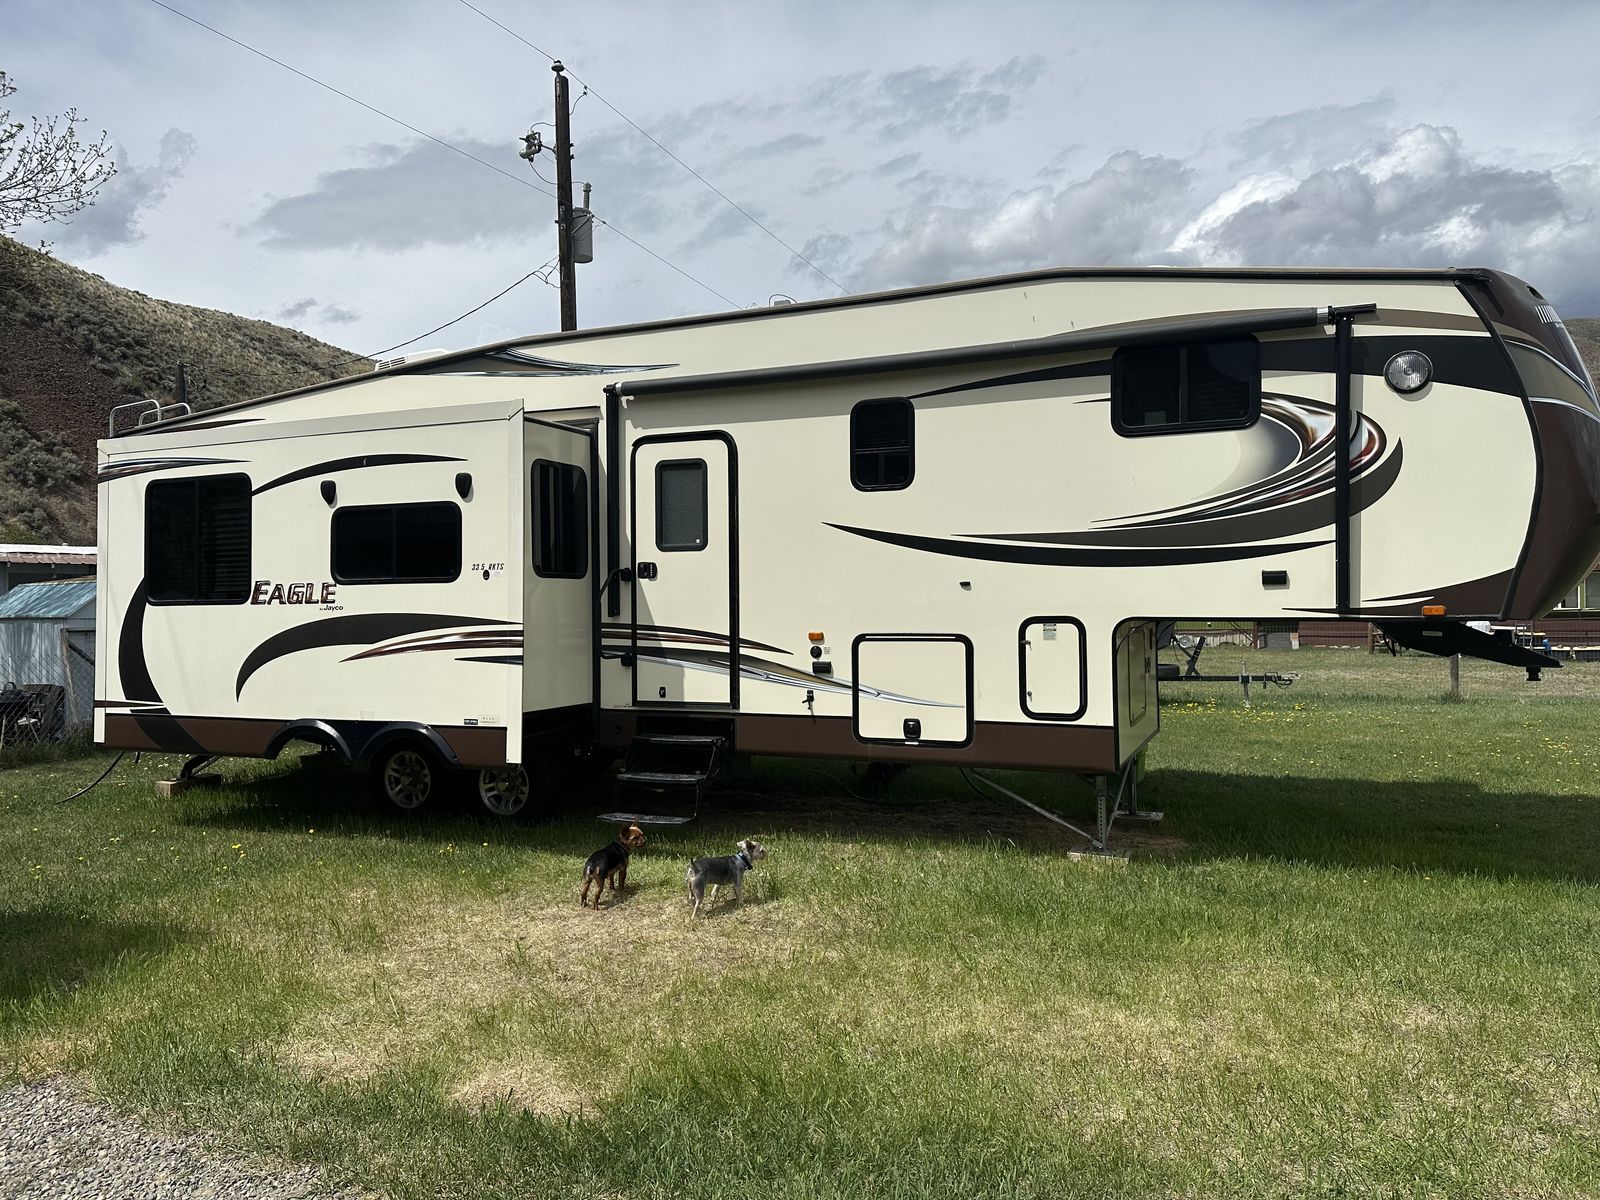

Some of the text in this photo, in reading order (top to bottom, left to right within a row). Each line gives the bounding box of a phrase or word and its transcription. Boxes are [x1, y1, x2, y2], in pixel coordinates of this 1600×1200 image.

[488, 562, 505, 571] RKTS
[250, 580, 337, 605] EAGLE
[323, 604, 344, 612] Jayco
